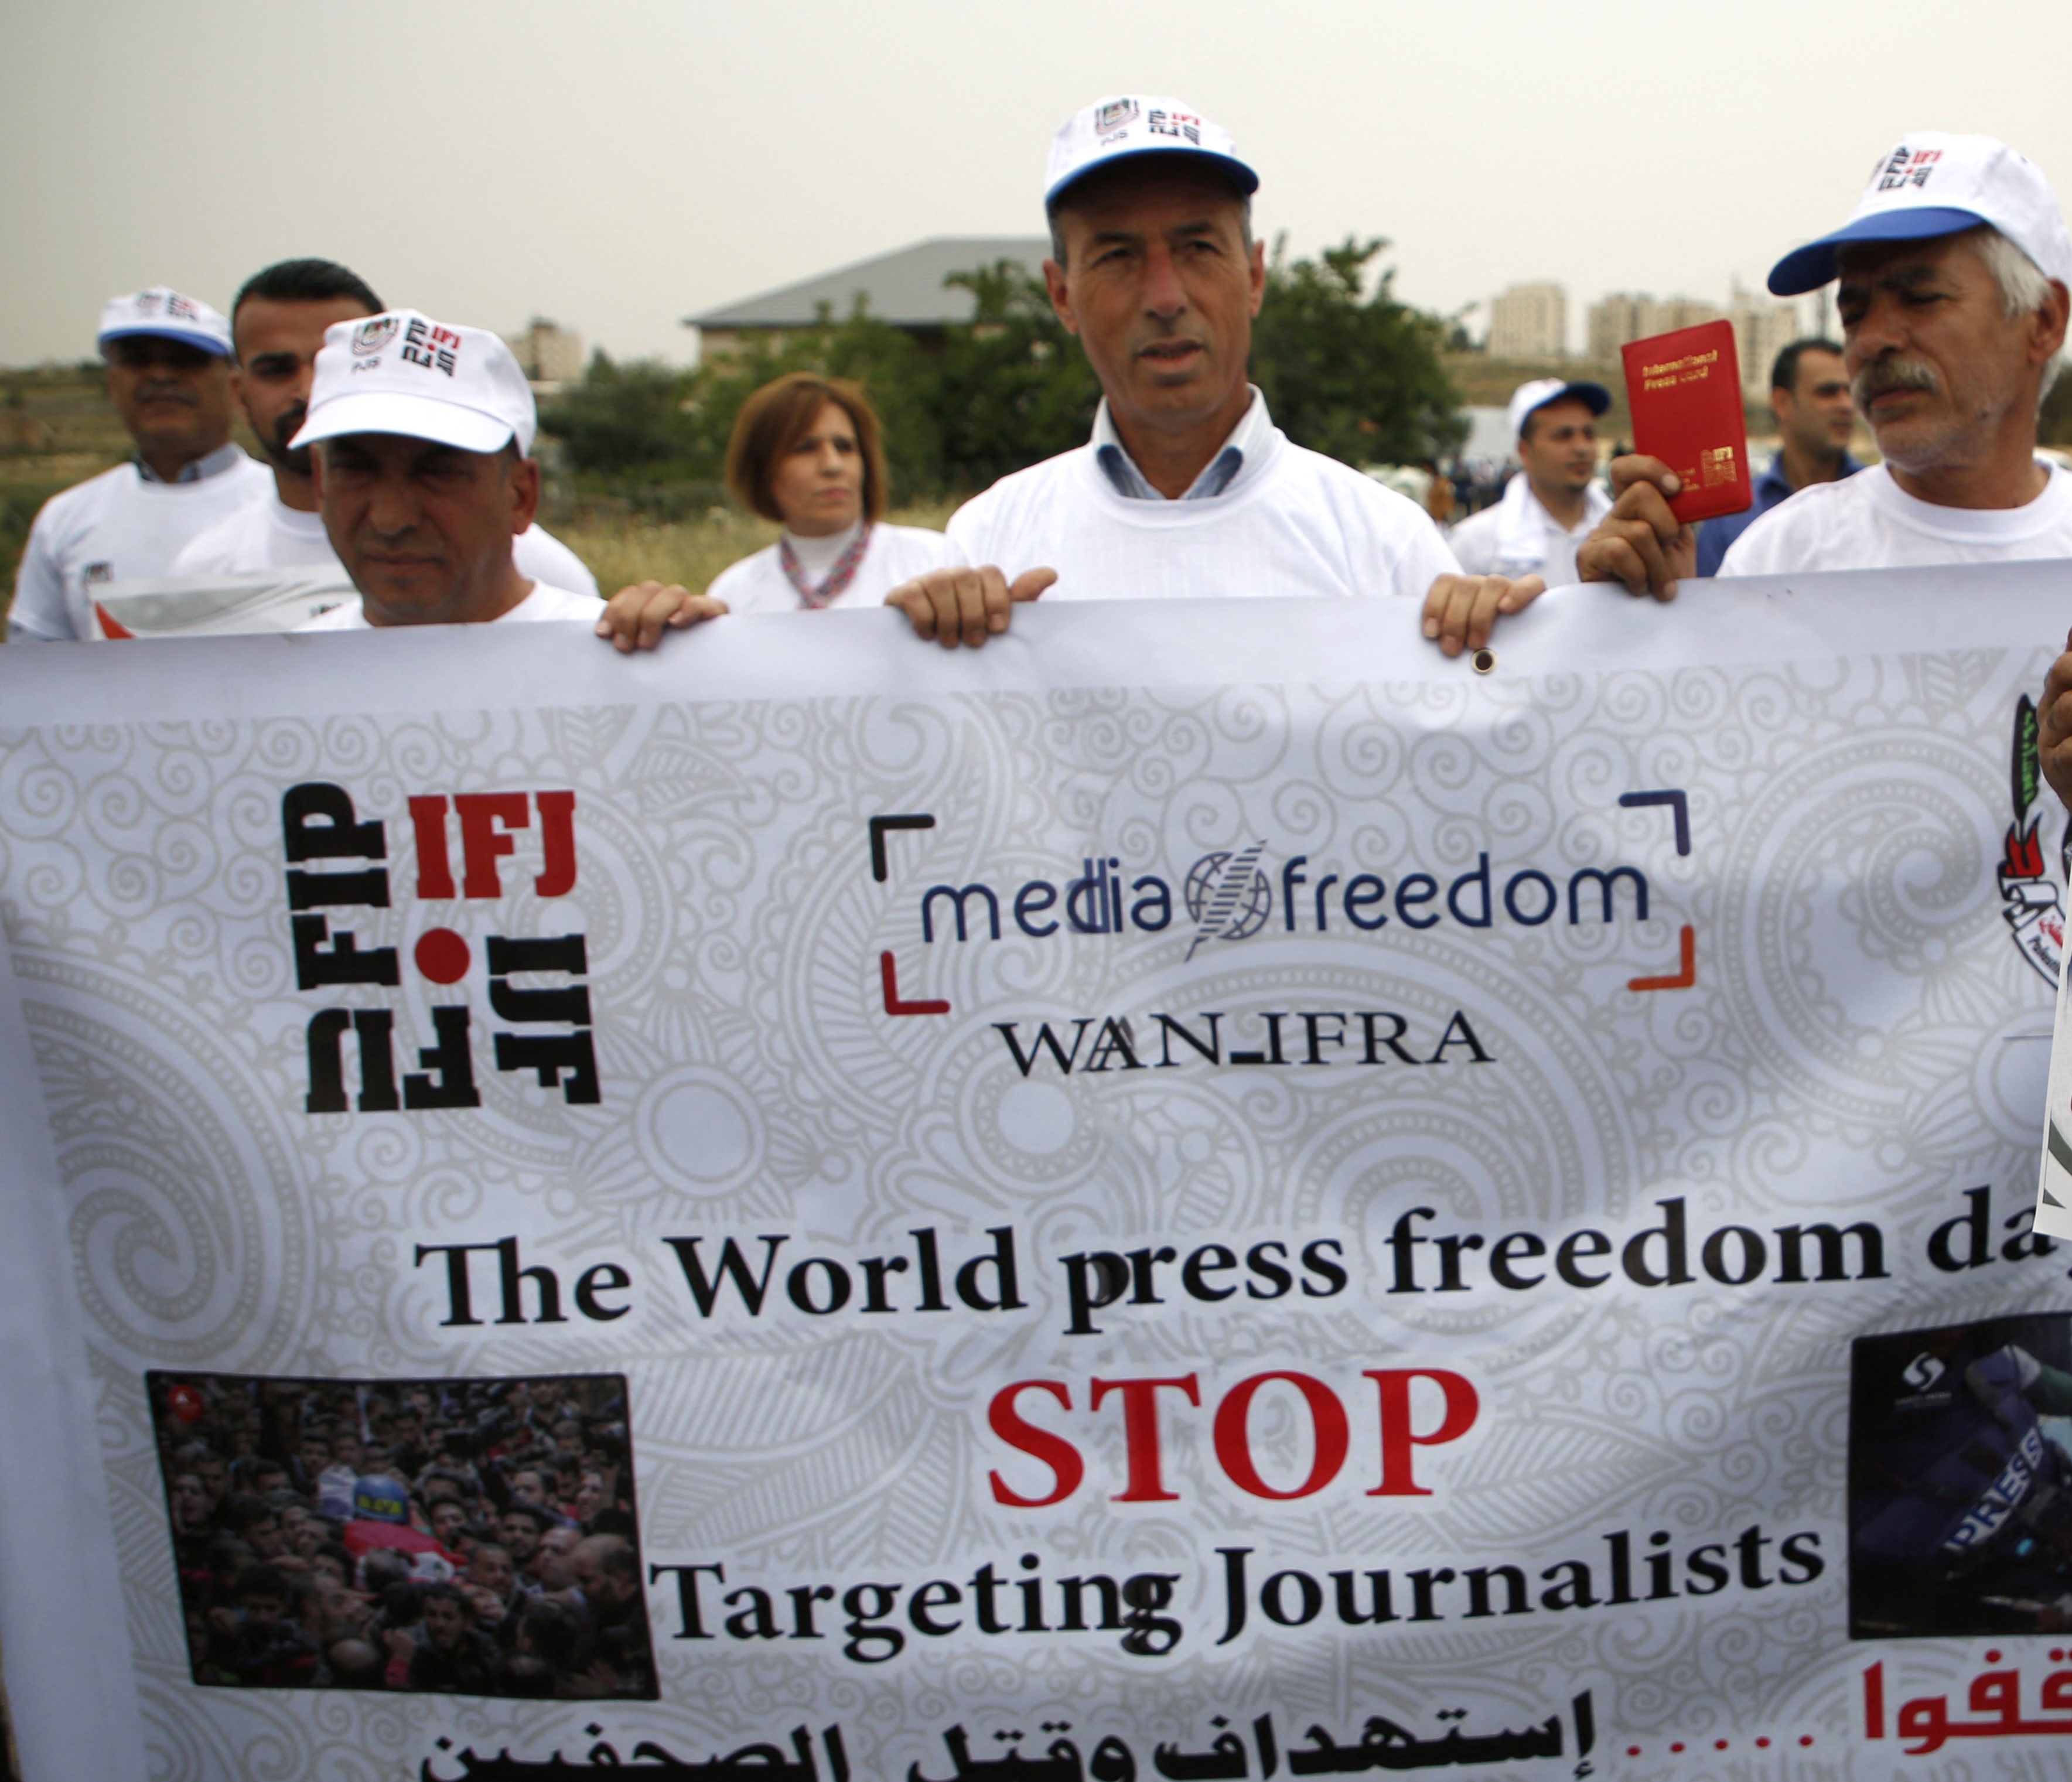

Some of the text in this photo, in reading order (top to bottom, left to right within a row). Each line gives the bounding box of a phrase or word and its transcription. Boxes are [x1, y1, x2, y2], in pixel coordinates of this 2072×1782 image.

[432, 326, 460, 348] IFJ
[1642, 349, 1718, 377] International
[1644, 374, 1678, 392] Press
[409, 791, 576, 899] IFJ
[921, 852, 1649, 943] media freedom
[414, 1235, 632, 1327] The
[661, 1225, 1029, 1318] World
[1058, 1239, 1349, 1336] press
[1384, 1197, 1893, 1294] freedom
[987, 1368, 1480, 1508] STOP
[1950, 1436, 2041, 1547] PRESS
[650, 1524, 1826, 1663] Targeting Journalists
